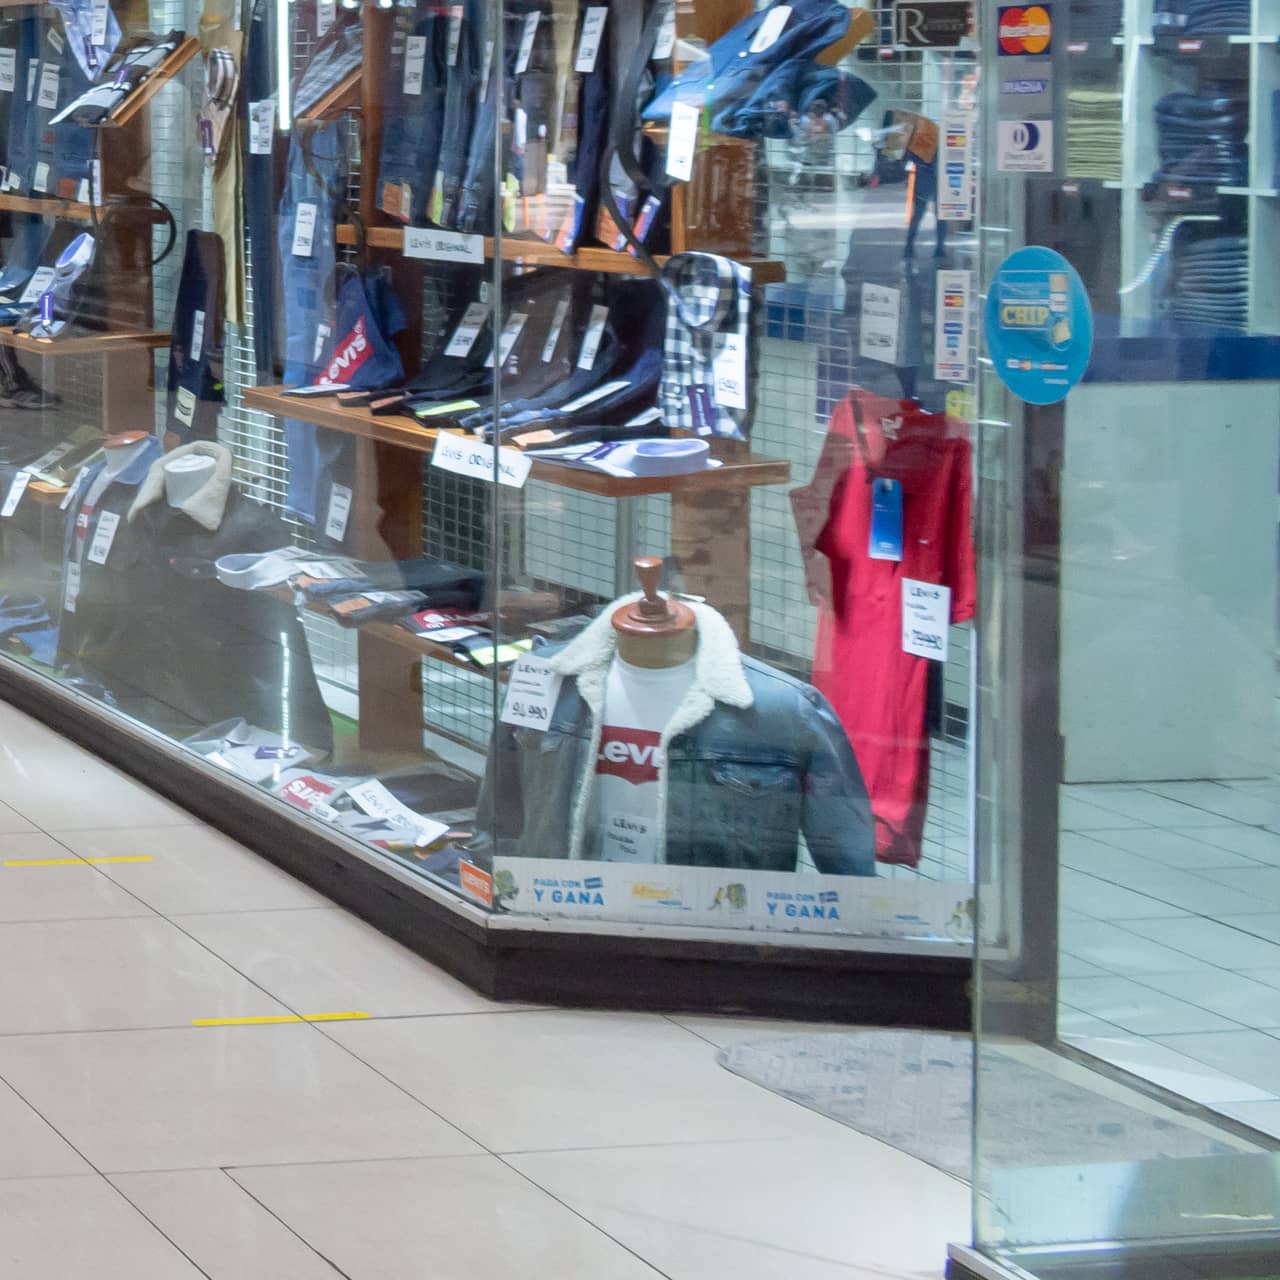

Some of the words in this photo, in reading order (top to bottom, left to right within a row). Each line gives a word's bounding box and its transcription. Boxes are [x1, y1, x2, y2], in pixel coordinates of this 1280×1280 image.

[1002, 306, 1050, 324] CHIP
[533, 889, 544, 902] Y
[551, 889, 605, 906] GANA
[767, 902, 778, 916] Y
[785, 903, 840, 920] GANA
